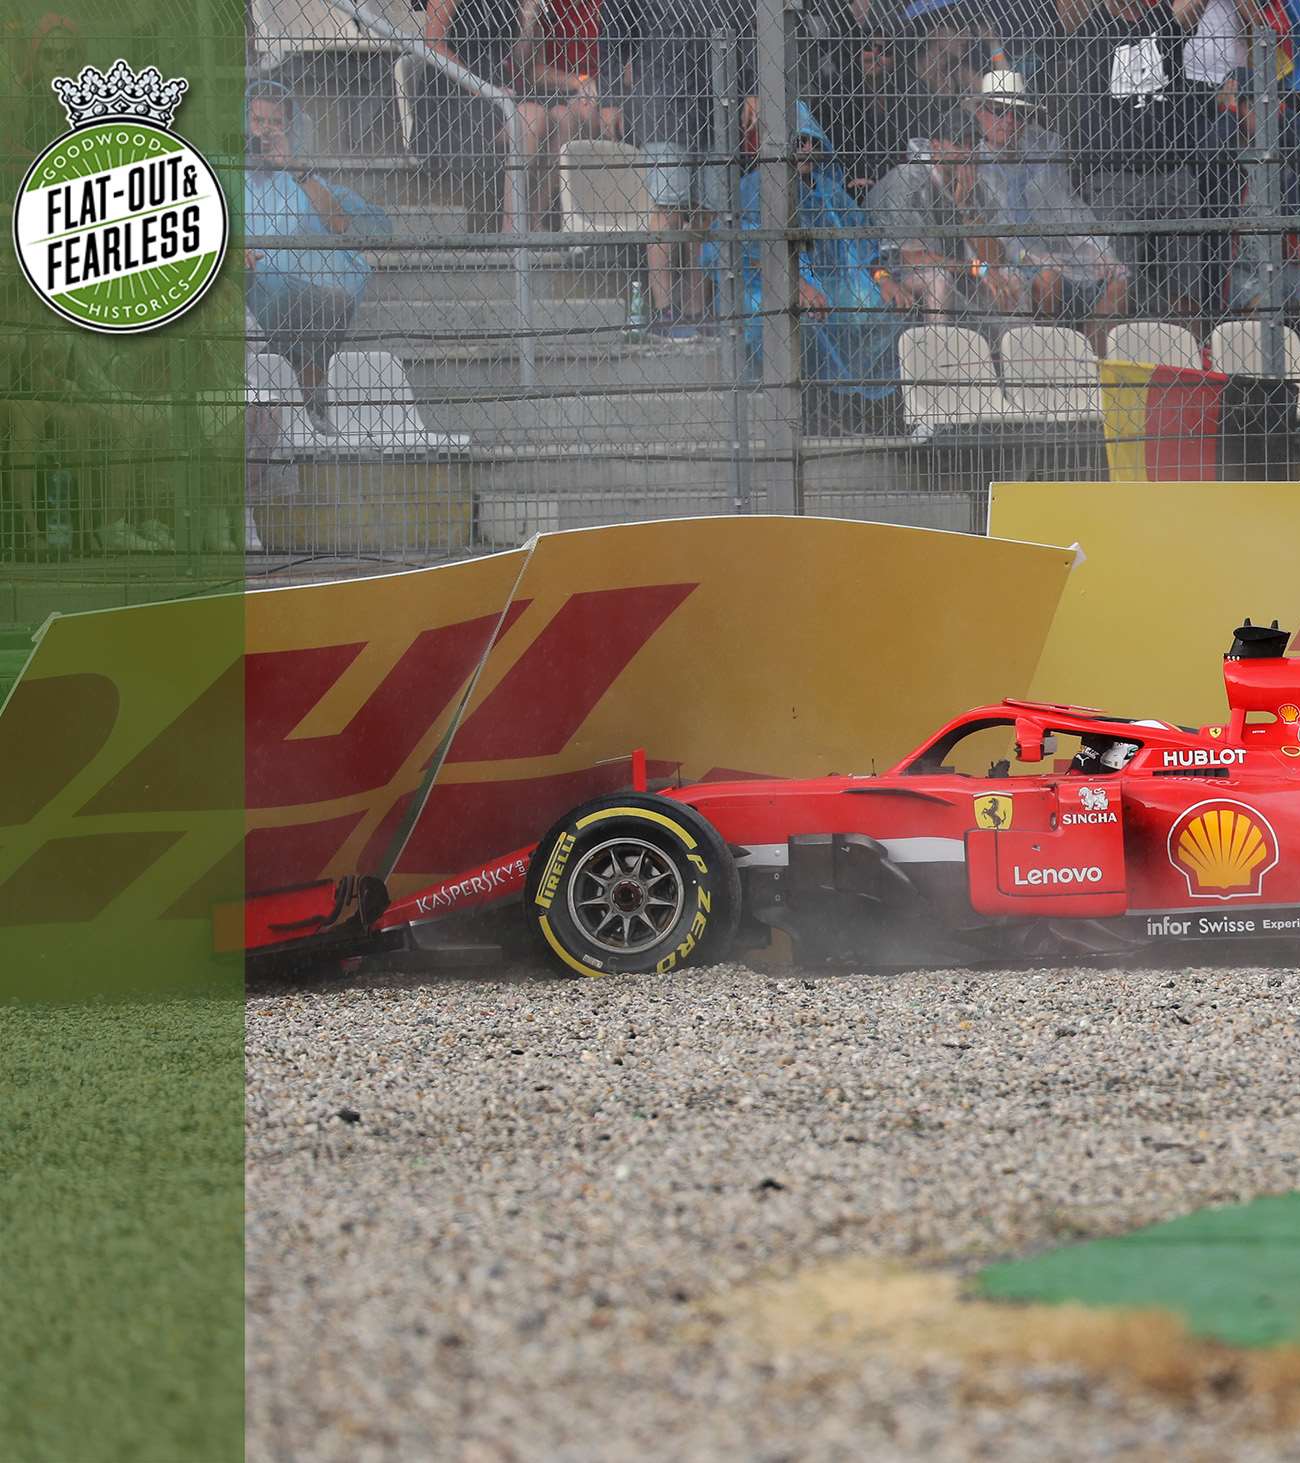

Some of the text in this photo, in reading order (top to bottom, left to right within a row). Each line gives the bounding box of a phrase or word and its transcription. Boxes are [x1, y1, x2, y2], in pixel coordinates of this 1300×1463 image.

[1163, 749, 1247, 767] HUBLOT
[1062, 812, 1118, 825] SINGHA
[535, 831, 577, 909] PIRELLI
[1014, 866, 1103, 886] Lenovo
[416, 863, 514, 914] KASPERSKY
[656, 854, 711, 974] P ZERO
[1147, 917, 1191, 936] infor
[1199, 918, 1256, 934] Swisse
